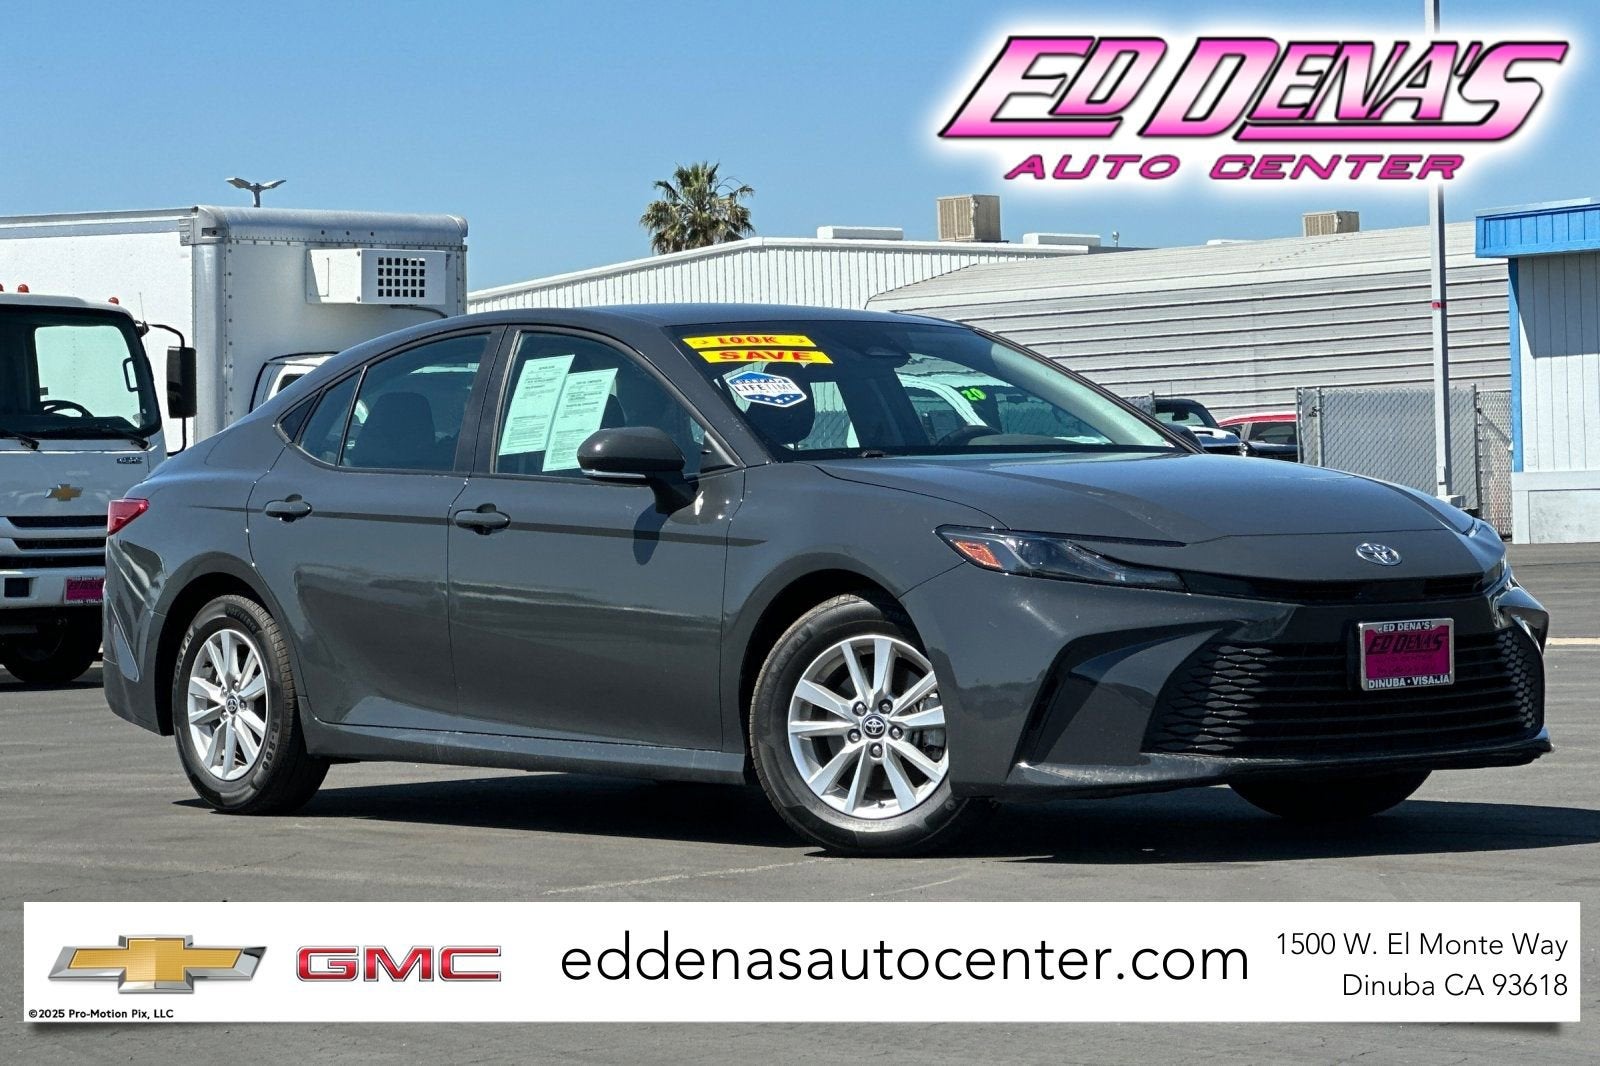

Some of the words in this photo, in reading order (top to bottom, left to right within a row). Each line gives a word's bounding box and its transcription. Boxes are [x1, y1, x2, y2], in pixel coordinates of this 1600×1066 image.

[717, 336, 778, 345] LOOK
[719, 351, 814, 361] SAVE
[734, 383, 796, 393] LIFETIME
[1383, 624, 1395, 632] ED
[1397, 621, 1431, 631] DENA'S
[1368, 678, 1406, 689] DINUBA
